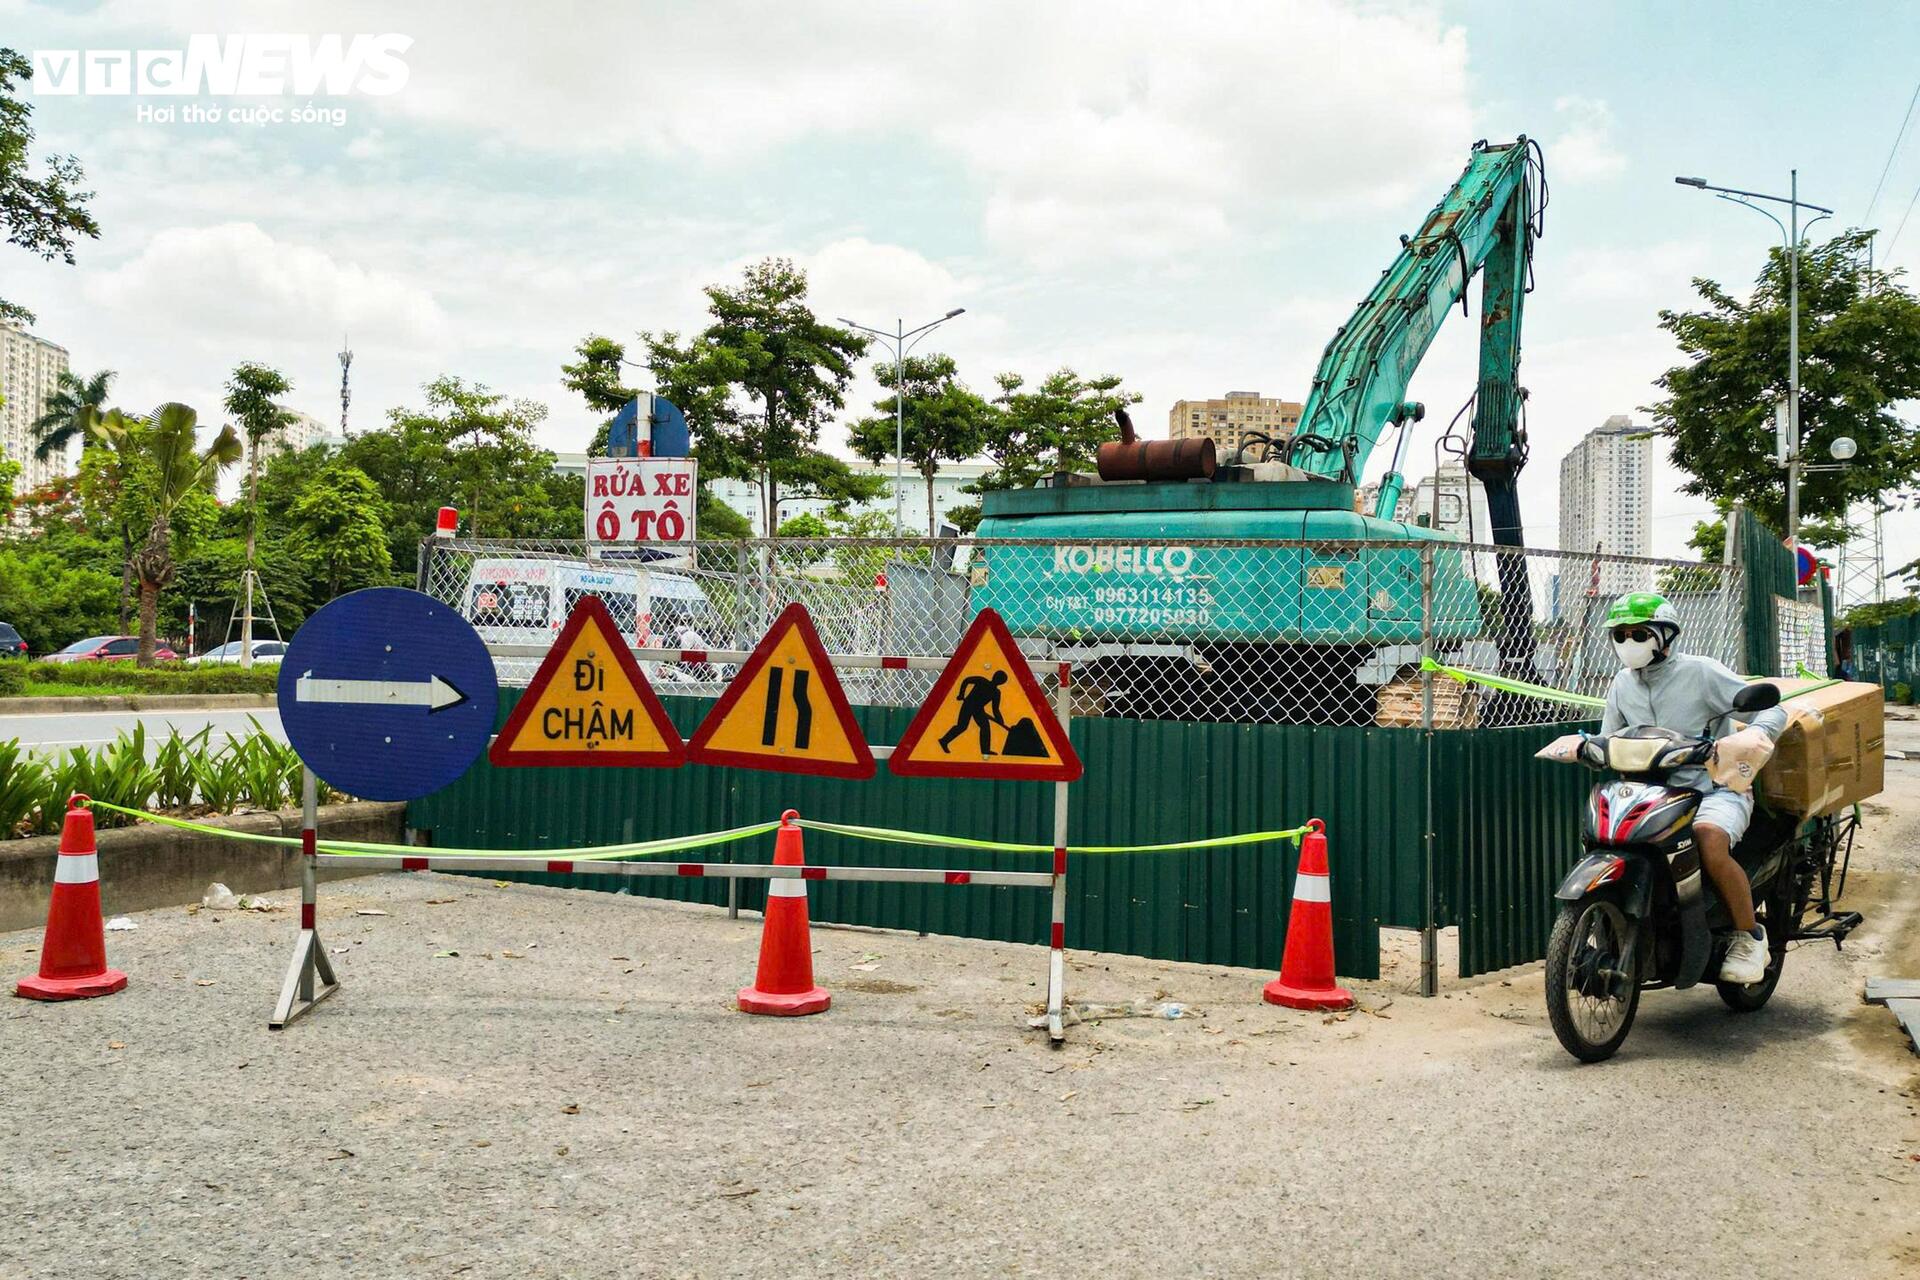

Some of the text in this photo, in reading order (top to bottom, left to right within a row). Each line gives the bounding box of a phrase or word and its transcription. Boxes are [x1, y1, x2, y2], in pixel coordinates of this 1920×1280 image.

[593, 466, 690, 497] RỬA XE
[596, 500, 685, 541] Ô TÔ
[1054, 546, 1194, 575] KOBELCO
[543, 700, 634, 747] CHẬM
